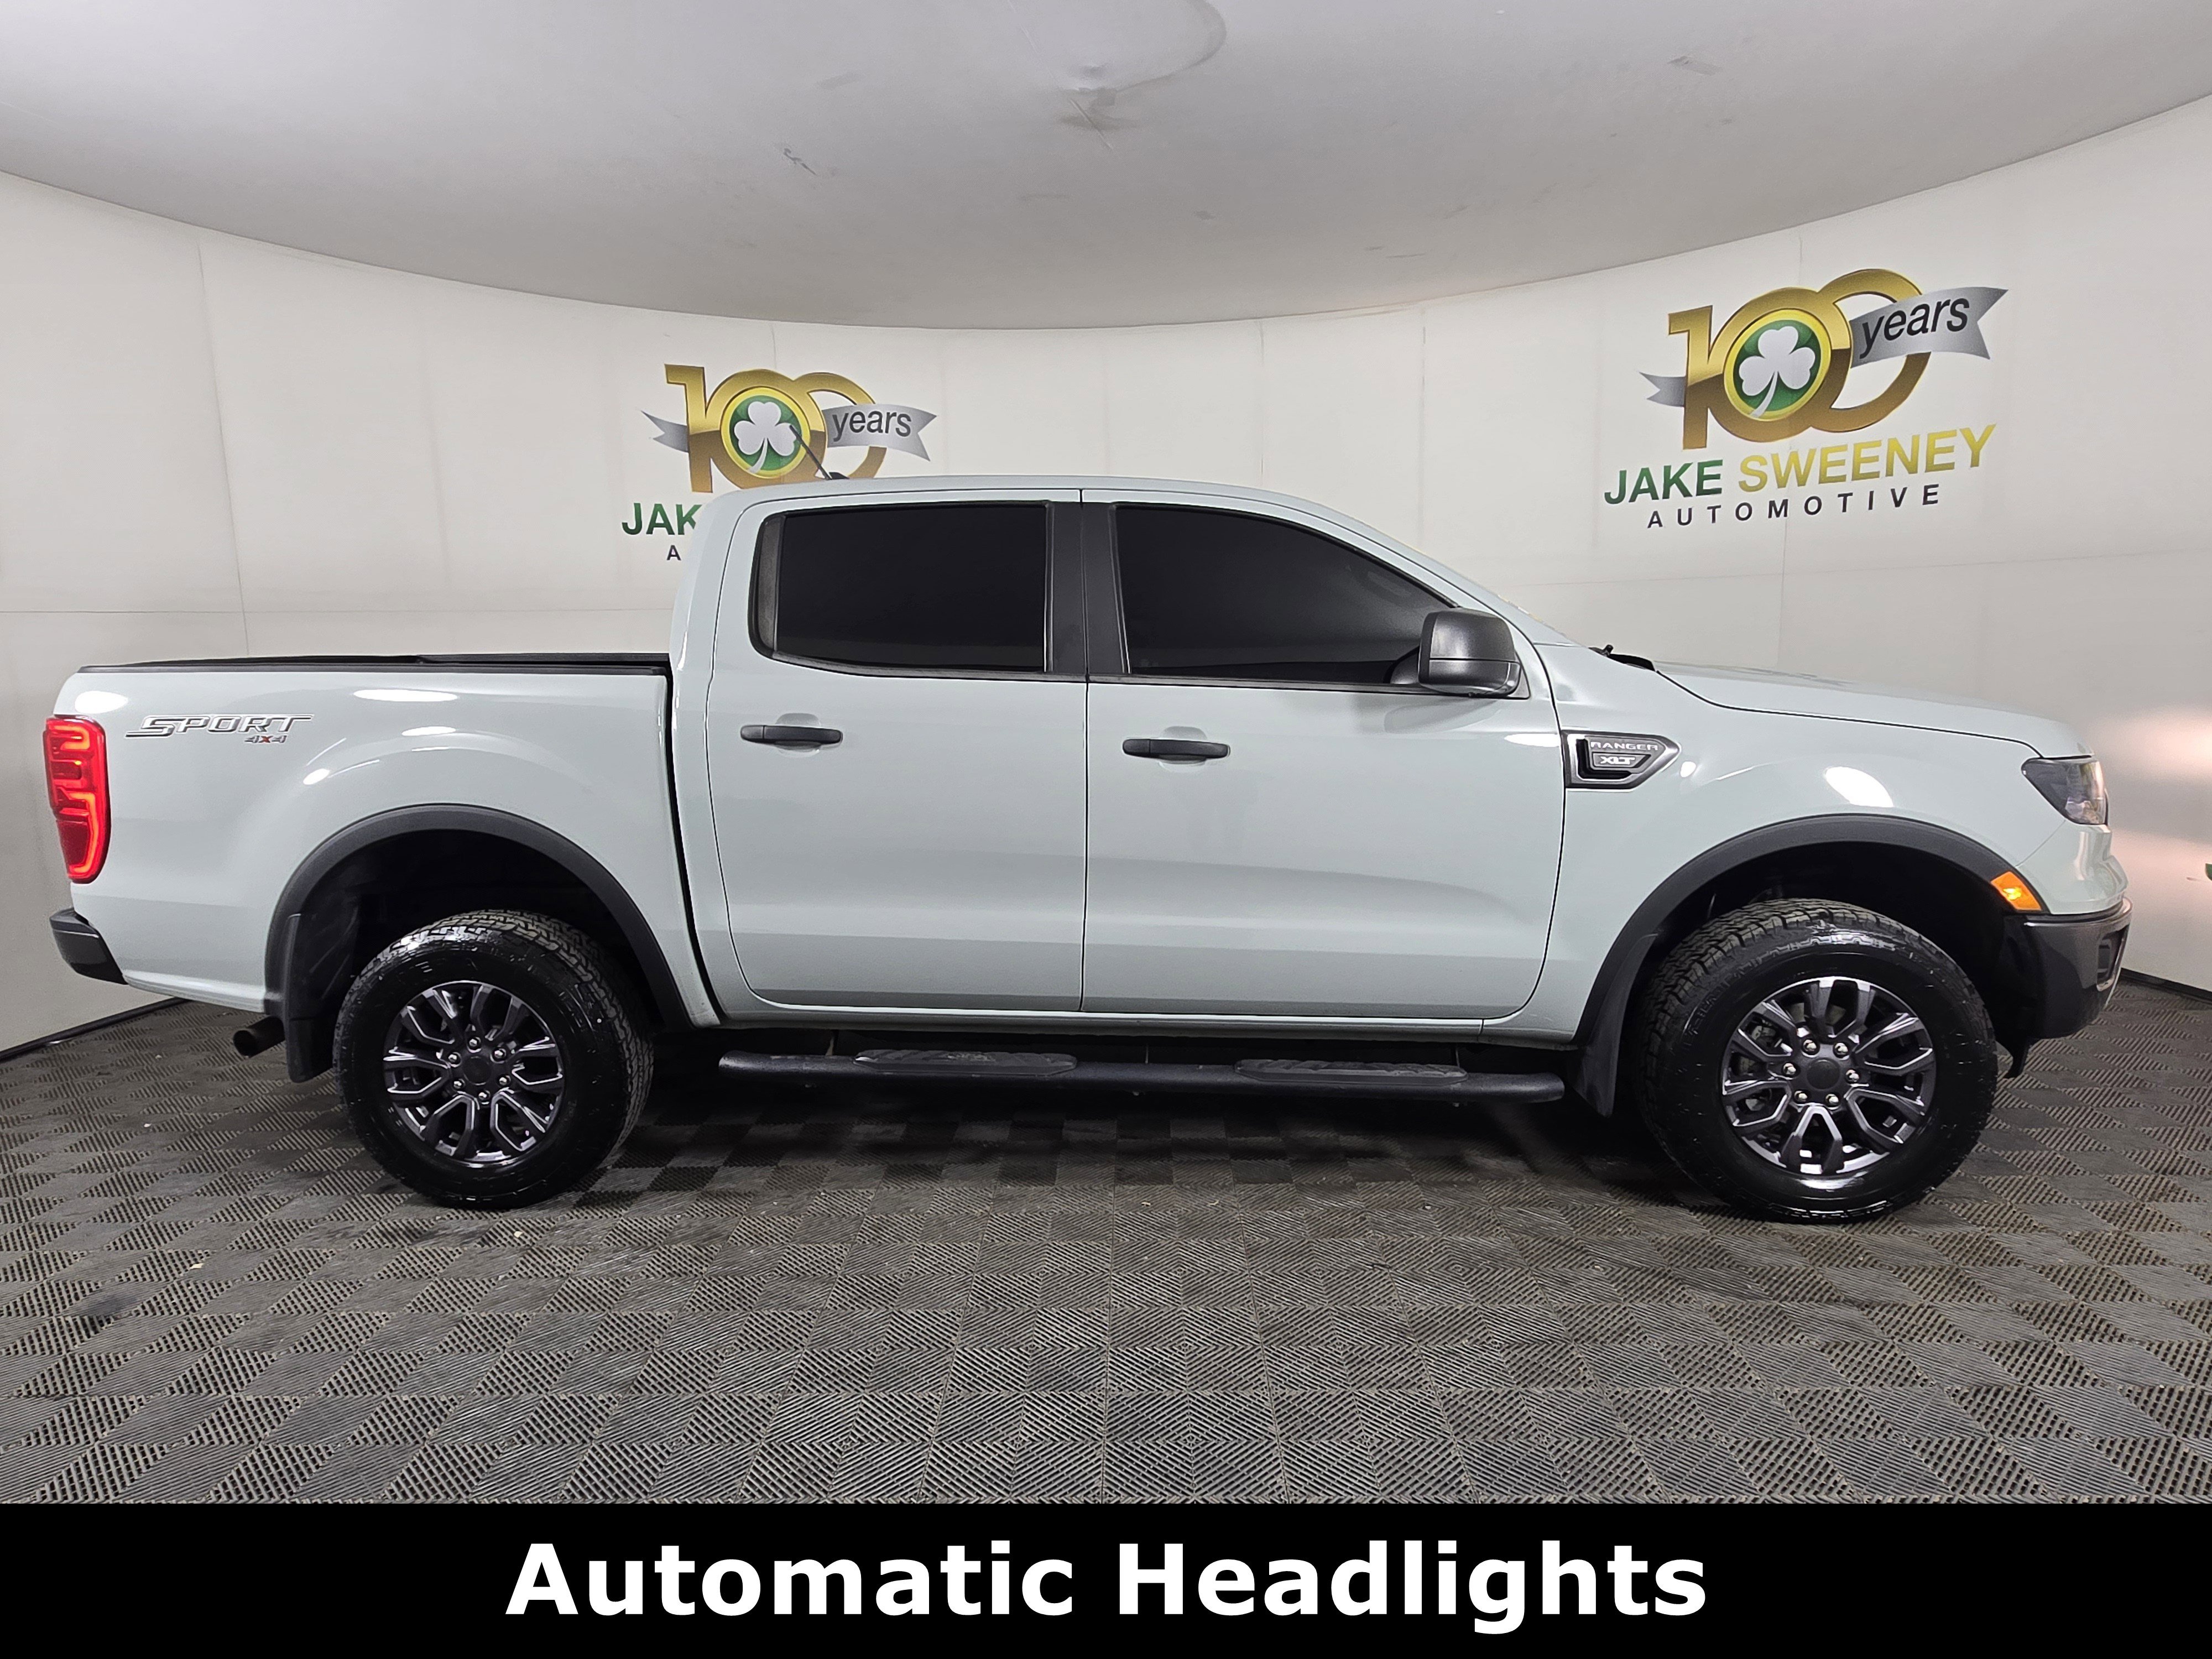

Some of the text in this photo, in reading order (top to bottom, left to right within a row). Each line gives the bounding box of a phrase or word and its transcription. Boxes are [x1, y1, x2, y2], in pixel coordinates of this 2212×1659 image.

[1667, 268, 1970, 450] 100 years
[832, 410, 912, 442] years
[1604, 424, 1997, 504] JAKE SWEENEY
[622, 503, 703, 535] JAK
[1647, 484, 1940, 529] AUTOMOTIVE
[124, 714, 314, 738] SPORT
[1590, 742, 1658, 750] RANGER
[1600, 756, 1635, 765] XLT
